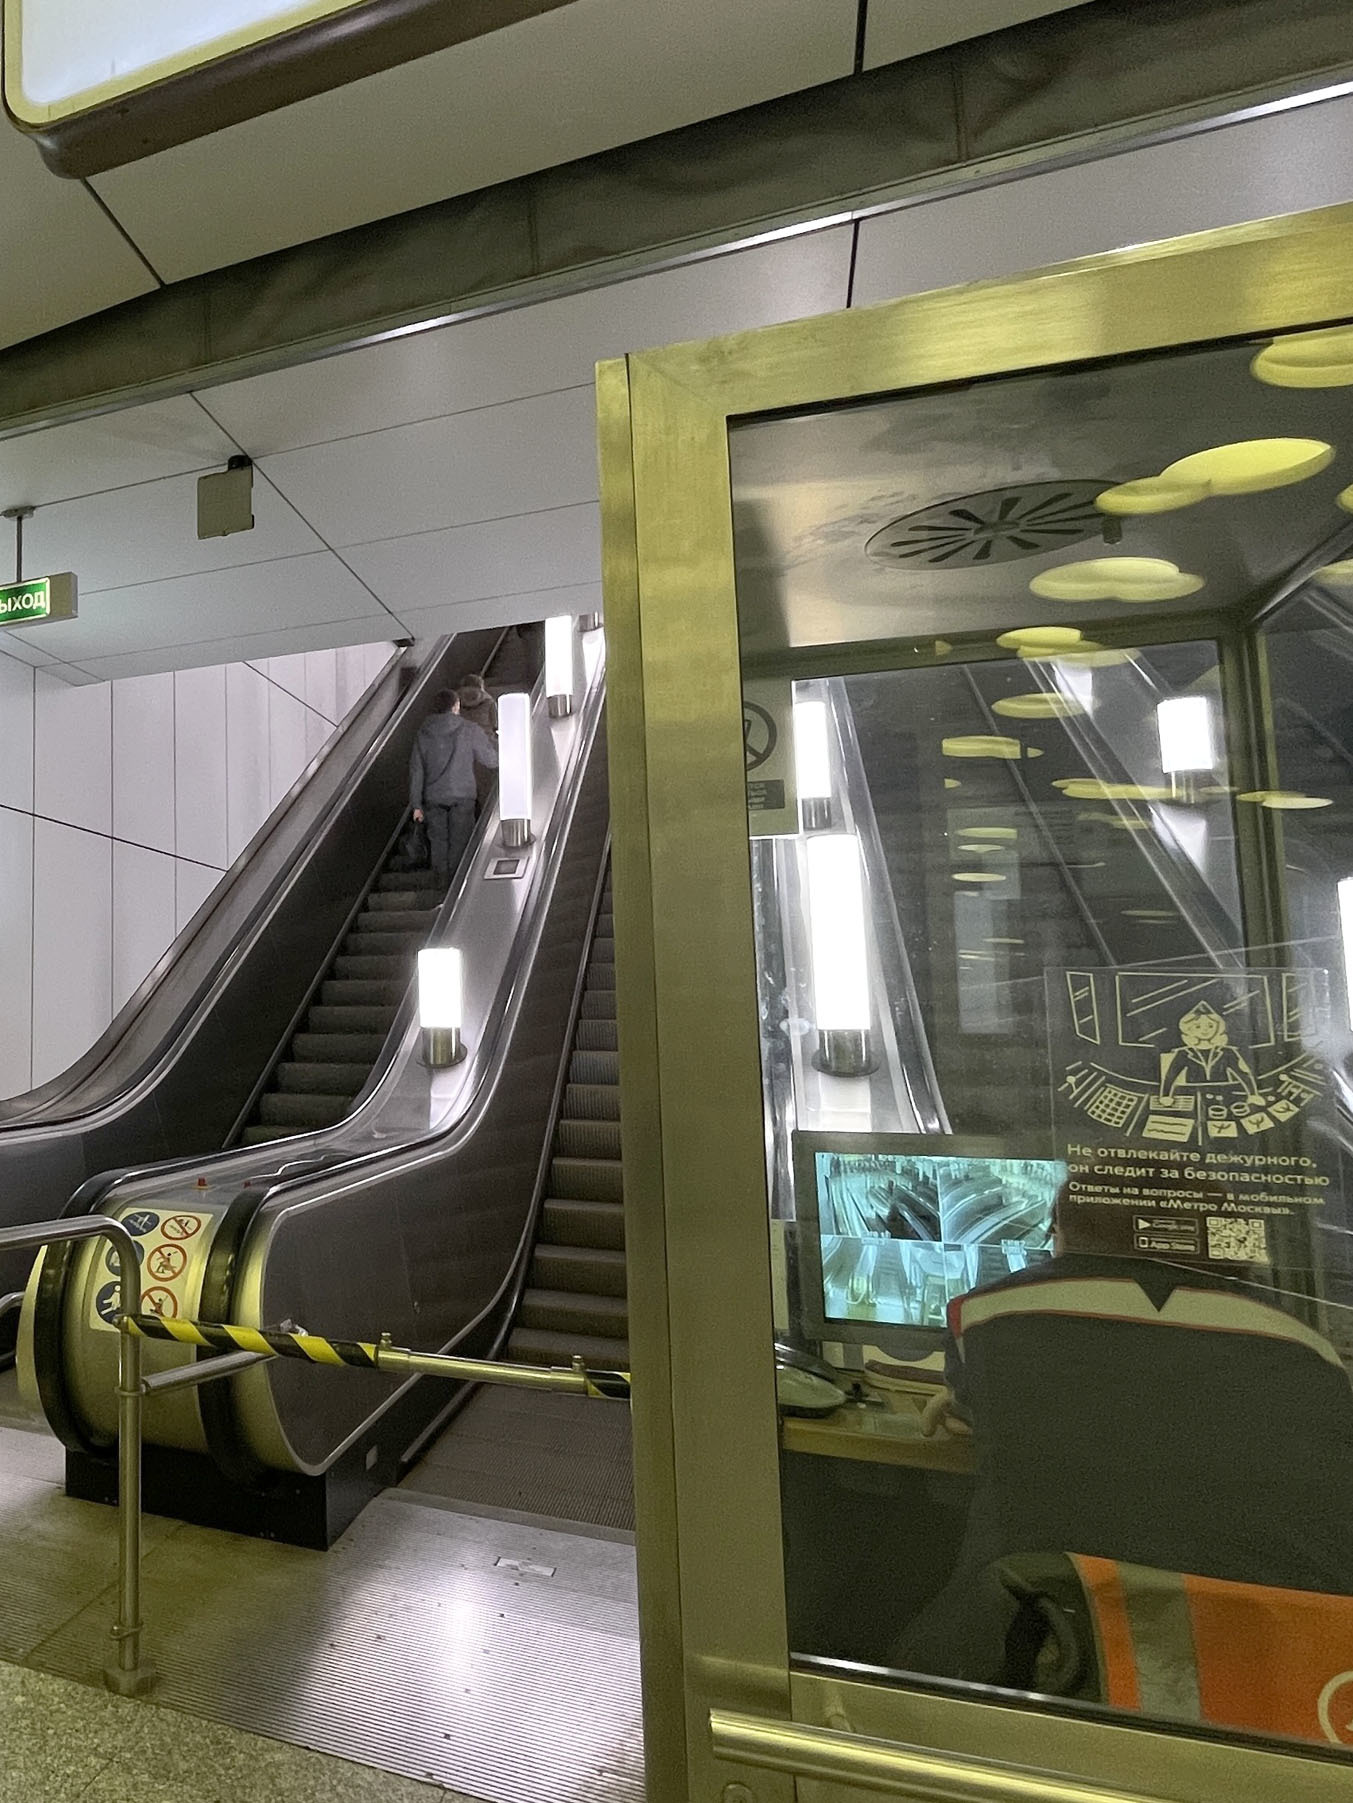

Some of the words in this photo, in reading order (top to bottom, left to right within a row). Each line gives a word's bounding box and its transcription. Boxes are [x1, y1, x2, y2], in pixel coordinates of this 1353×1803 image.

[1068, 1144, 1092, 1156] Не
[1097, 1147, 1201, 1161] отвлекайте
[1205, 1152, 1317, 1168] дежурного.
[1068, 1164, 1089, 1174] он
[1094, 1164, 1155, 1177] следит
[1160, 1168, 1179, 1178] за
[1184, 1166, 1330, 1185] безопасностью
[1069, 1181, 1120, 1193] Ответы
[1142, 1188, 1203, 1199] вопросы
[1238, 1191, 1326, 1205] мобильном
[1069, 1194, 1156, 1206] приложении
[1159, 1198, 1218, 1212] «Метро
[1221, 1202, 1295, 1215] Москвы».
